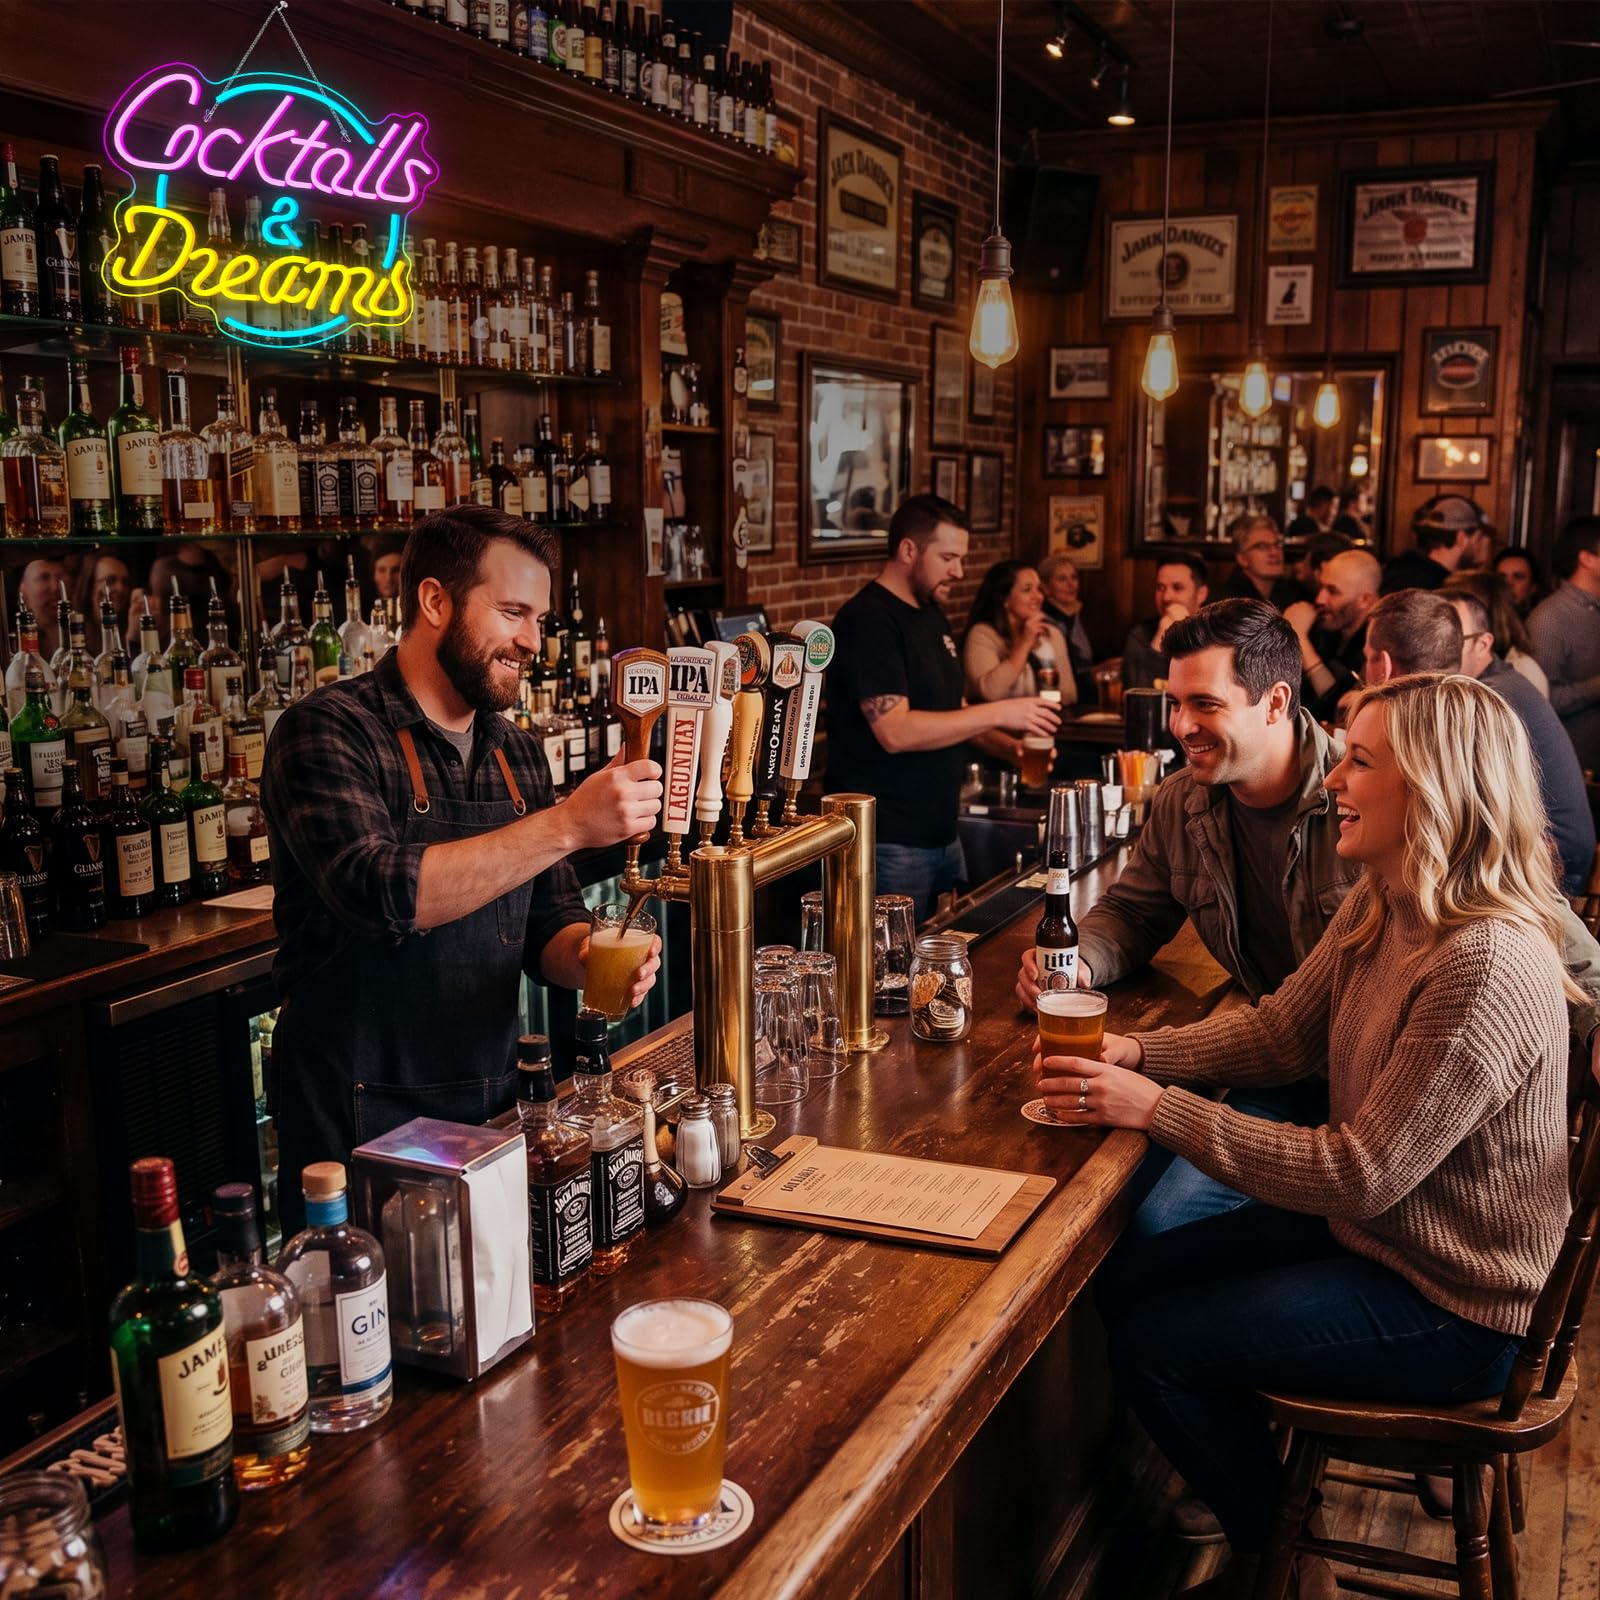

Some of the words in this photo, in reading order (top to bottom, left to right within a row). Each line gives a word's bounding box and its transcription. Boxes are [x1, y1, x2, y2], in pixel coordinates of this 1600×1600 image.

[113, 72, 433, 204] Cocktails
[262, 196, 304, 248] &
[112, 205, 408, 318] Dreams
[628, 675, 660, 696] IPA
[669, 664, 710, 694] IPA
[1043, 952, 1075, 972] Lite
[351, 1301, 386, 1336] GIN
